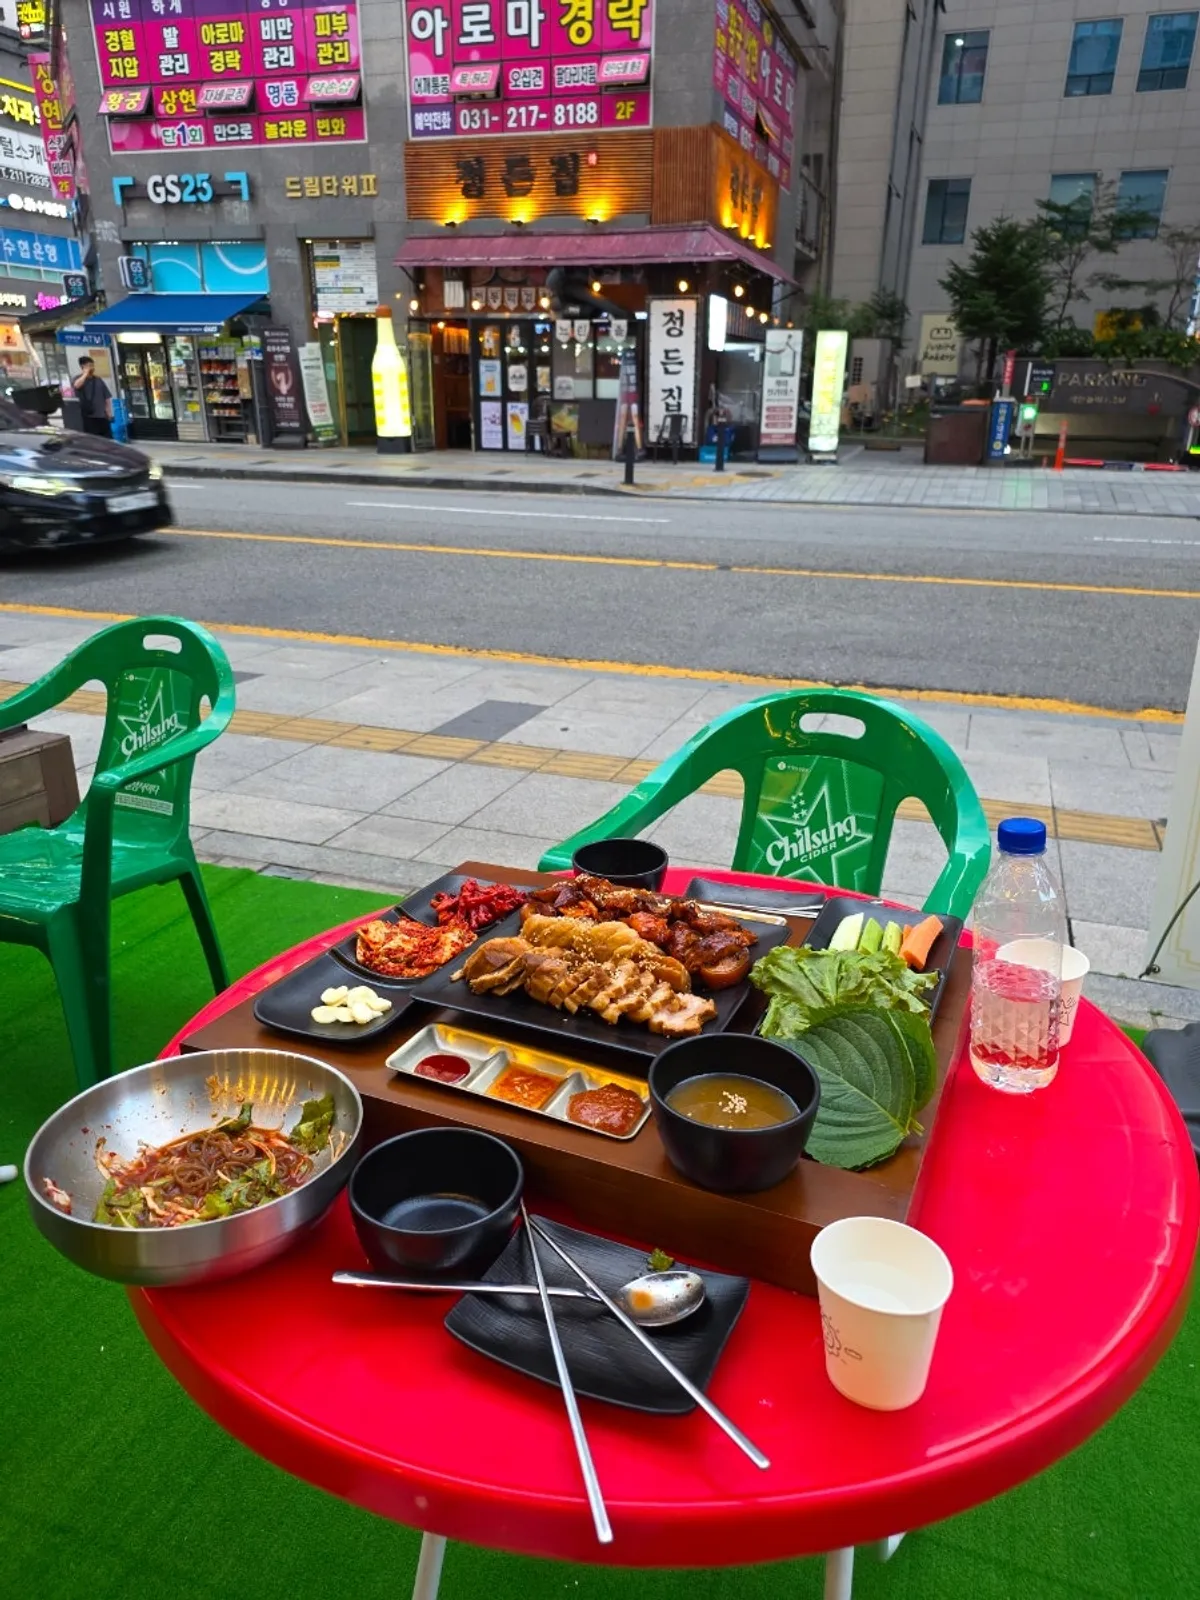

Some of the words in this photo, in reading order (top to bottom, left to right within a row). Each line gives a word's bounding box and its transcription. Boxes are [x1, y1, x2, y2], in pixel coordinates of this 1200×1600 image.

[201, 21, 244, 45] 아로마
[260, 17, 293, 40] 비만
[314, 12, 348, 36] 피부
[411, 2, 545, 56] 아로마
[560, 0, 648, 45] 경락
[162, 26, 179, 48] 발
[159, 53, 189, 76] 관리
[210, 49, 241, 73] 경락
[263, 45, 295, 69] 관리
[317, 41, 350, 65] 관리
[109, 56, 139, 78] 지압
[510, 69, 543, 89] 오십견
[161, 88, 198, 114] 상현
[266, 82, 298, 106] 명품
[460, 108, 500, 130] 031-
[507, 106, 547, 128] 217-
[554, 102, 598, 126] 8188
[615, 101, 636, 120] 2F
[161, 122, 205, 146] 단1회
[214, 123, 253, 142] 만으로
[265, 119, 307, 139] 놀라운
[316, 117, 346, 136] 변화
[0, 136, 49, 165] 털스캐
[147, 172, 213, 204] GS25
[3, 238, 58, 262] 수협은행
[67, 277, 83, 287] GS
[660, 308, 685, 413] 정든집
[1058, 372, 1147, 387] PARKING
[121, 712, 178, 756] Chilsung
[766, 815, 856, 867] Chilsung
[800, 841, 838, 863] CIDER
